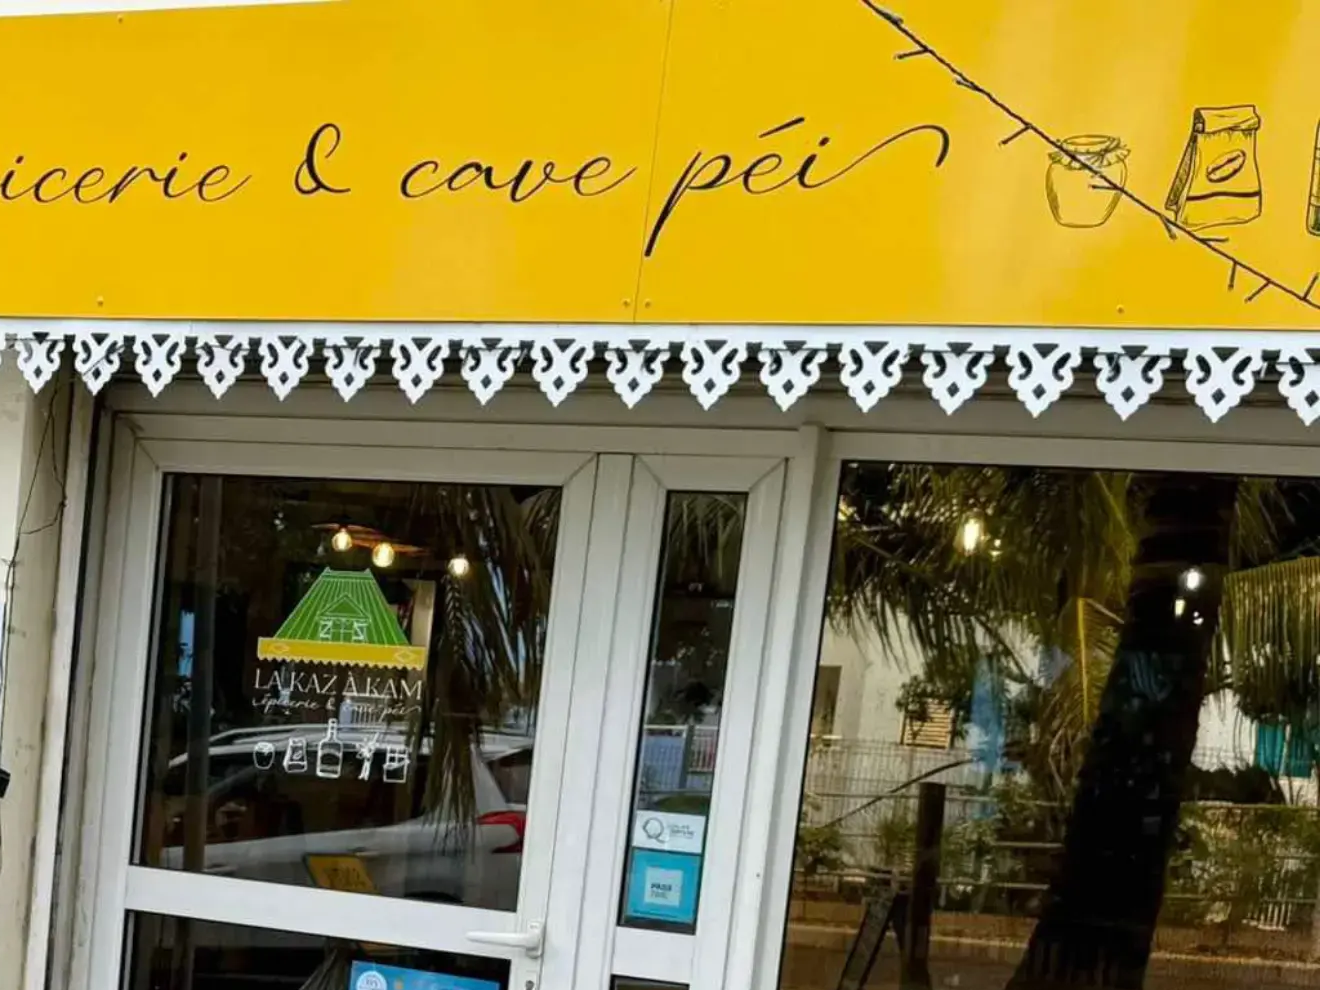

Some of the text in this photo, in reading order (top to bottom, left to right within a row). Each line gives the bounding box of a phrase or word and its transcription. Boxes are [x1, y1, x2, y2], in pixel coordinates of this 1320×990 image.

[293, 122, 352, 196] &
[399, 154, 638, 203] cave
[643, 116, 950, 257] péi
[254, 668, 422, 700] LA KAZ À KAM
